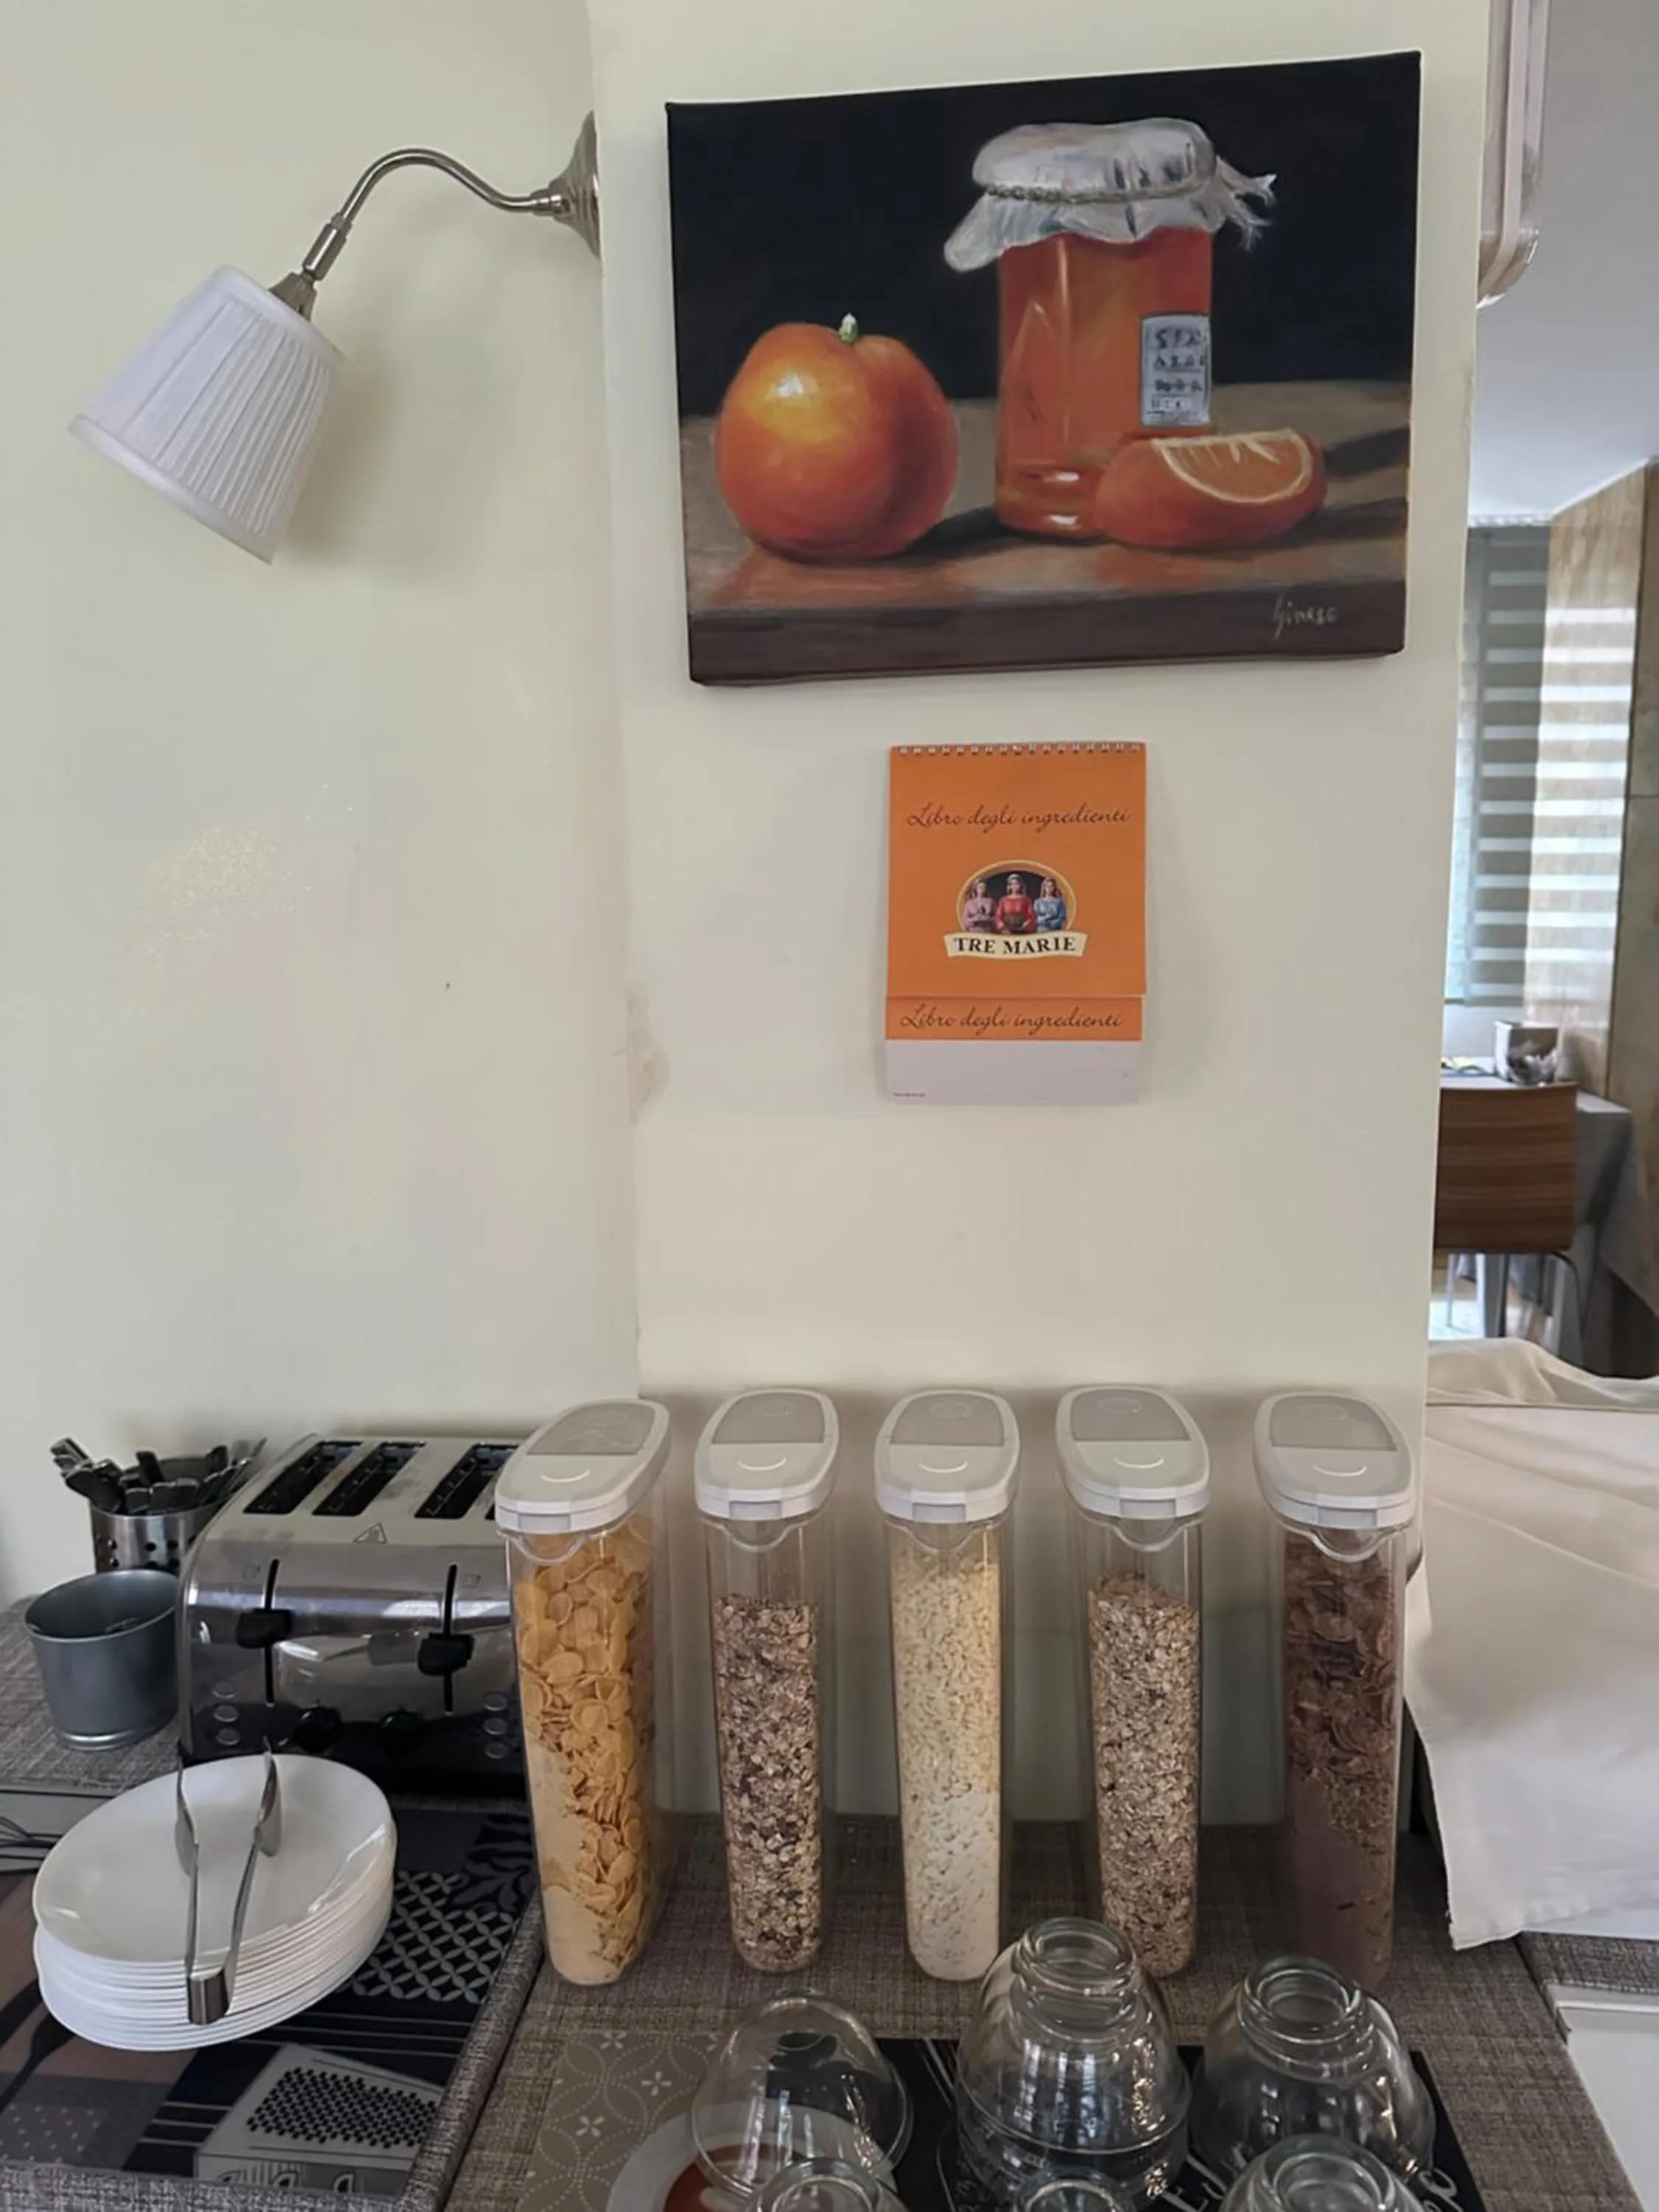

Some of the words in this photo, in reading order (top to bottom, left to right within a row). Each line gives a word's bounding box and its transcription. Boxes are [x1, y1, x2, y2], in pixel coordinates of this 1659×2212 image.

[907, 803, 961, 828] Libro
[967, 804, 1017, 833] degli
[1021, 802, 1130, 832] ingredienti
[953, 937, 995, 954] TRE
[1002, 936, 1076, 955] MARIE
[900, 1003, 954, 1029] Libro
[960, 1006, 1008, 1036] degli
[1013, 1006, 1123, 1035] ingredienti
